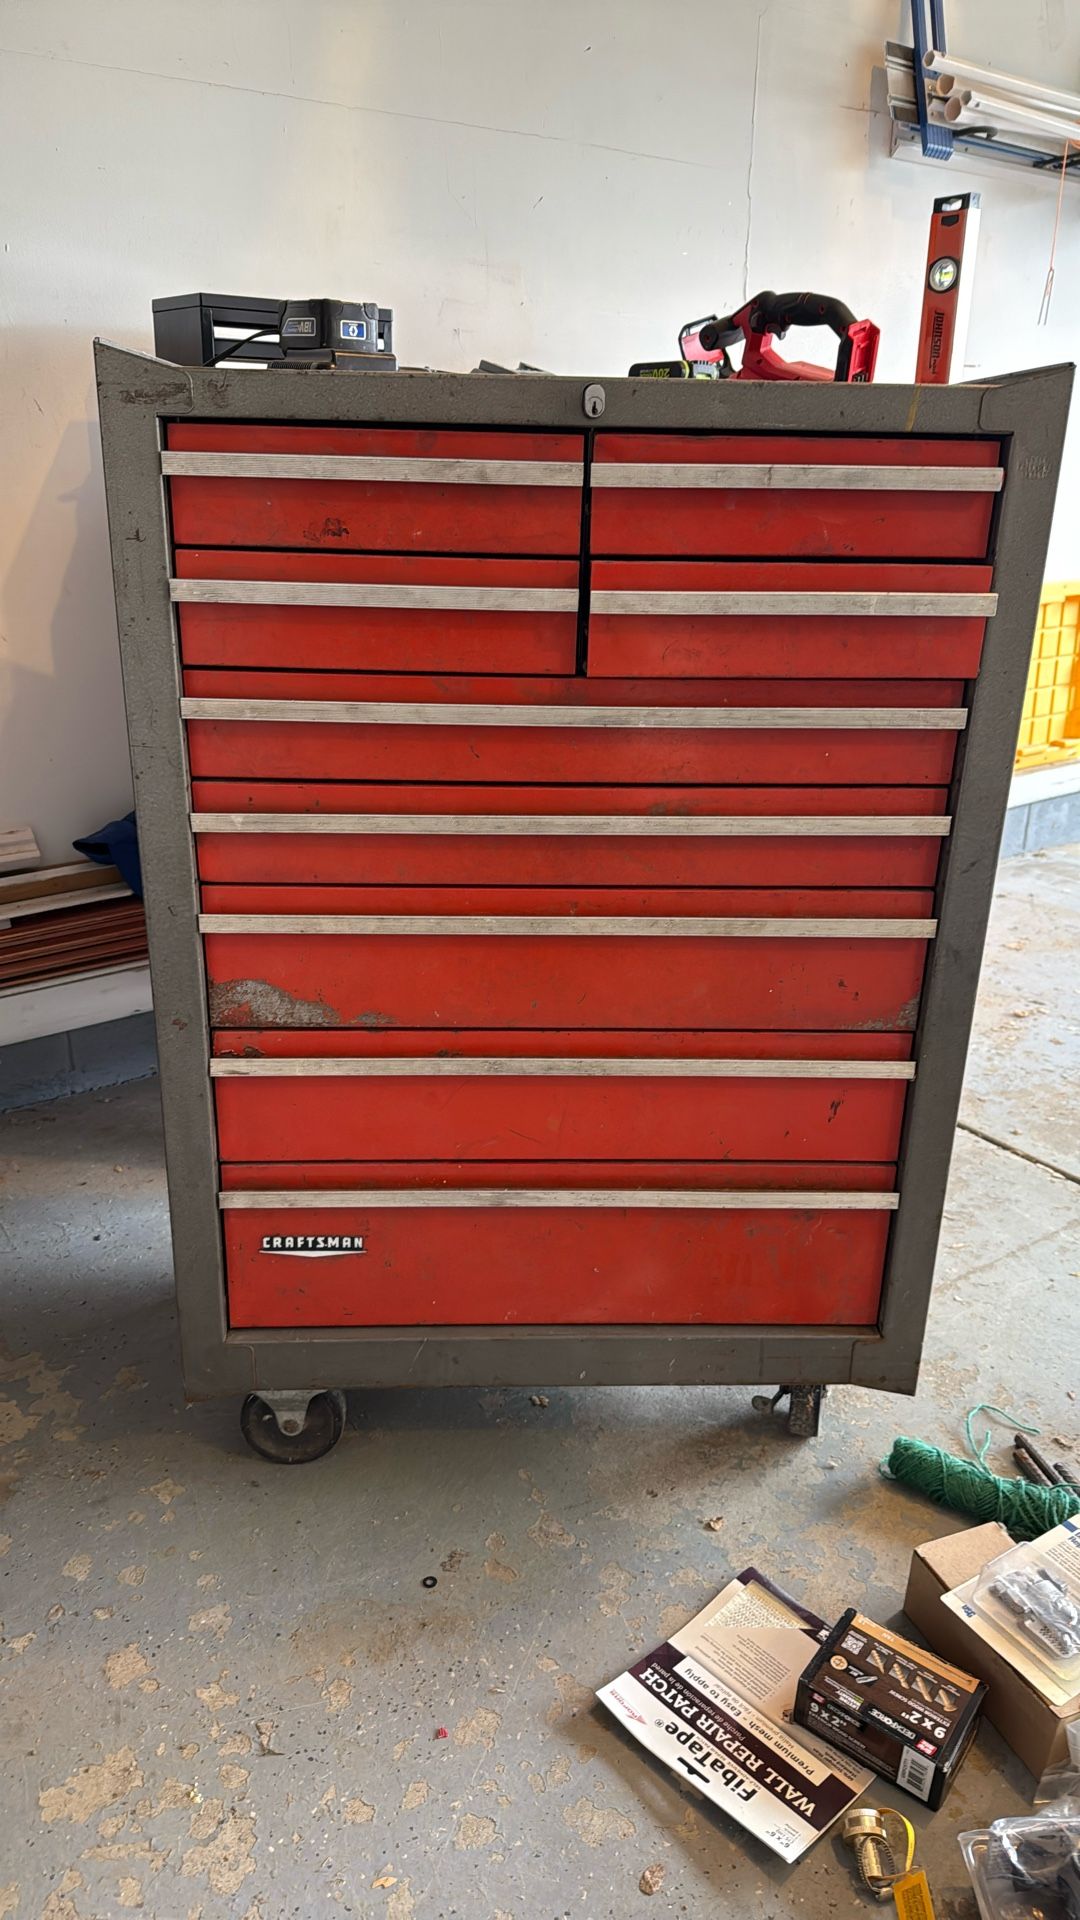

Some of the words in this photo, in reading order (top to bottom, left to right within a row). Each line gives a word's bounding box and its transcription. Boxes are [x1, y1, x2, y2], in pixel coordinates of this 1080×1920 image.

[932, 311, 944, 358] JOHNSON
[262, 1236, 363, 1249] CRAFTSMAN
[650, 1660, 670, 1679] pared
[666, 1675, 675, 1683] la
[683, 1666, 711, 1691] apply
[638, 1665, 699, 1719] PATCH
[672, 1679, 684, 1691] de
[708, 1687, 720, 1698] to
[681, 1686, 716, 1717] reparación
[718, 1695, 743, 1717] Easy
[807, 1701, 820, 1713] 9
[819, 1710, 830, 1720] x
[713, 1713, 726, 1725] de
[919, 1716, 935, 1730] x
[724, 1721, 746, 1741] Parche
[747, 1719, 774, 1743] mesh
[932, 1724, 947, 1739] 9
[694, 1712, 764, 1772] REPAIR
[771, 1739, 814, 1776] Premium
[760, 1766, 817, 1816] WALL
